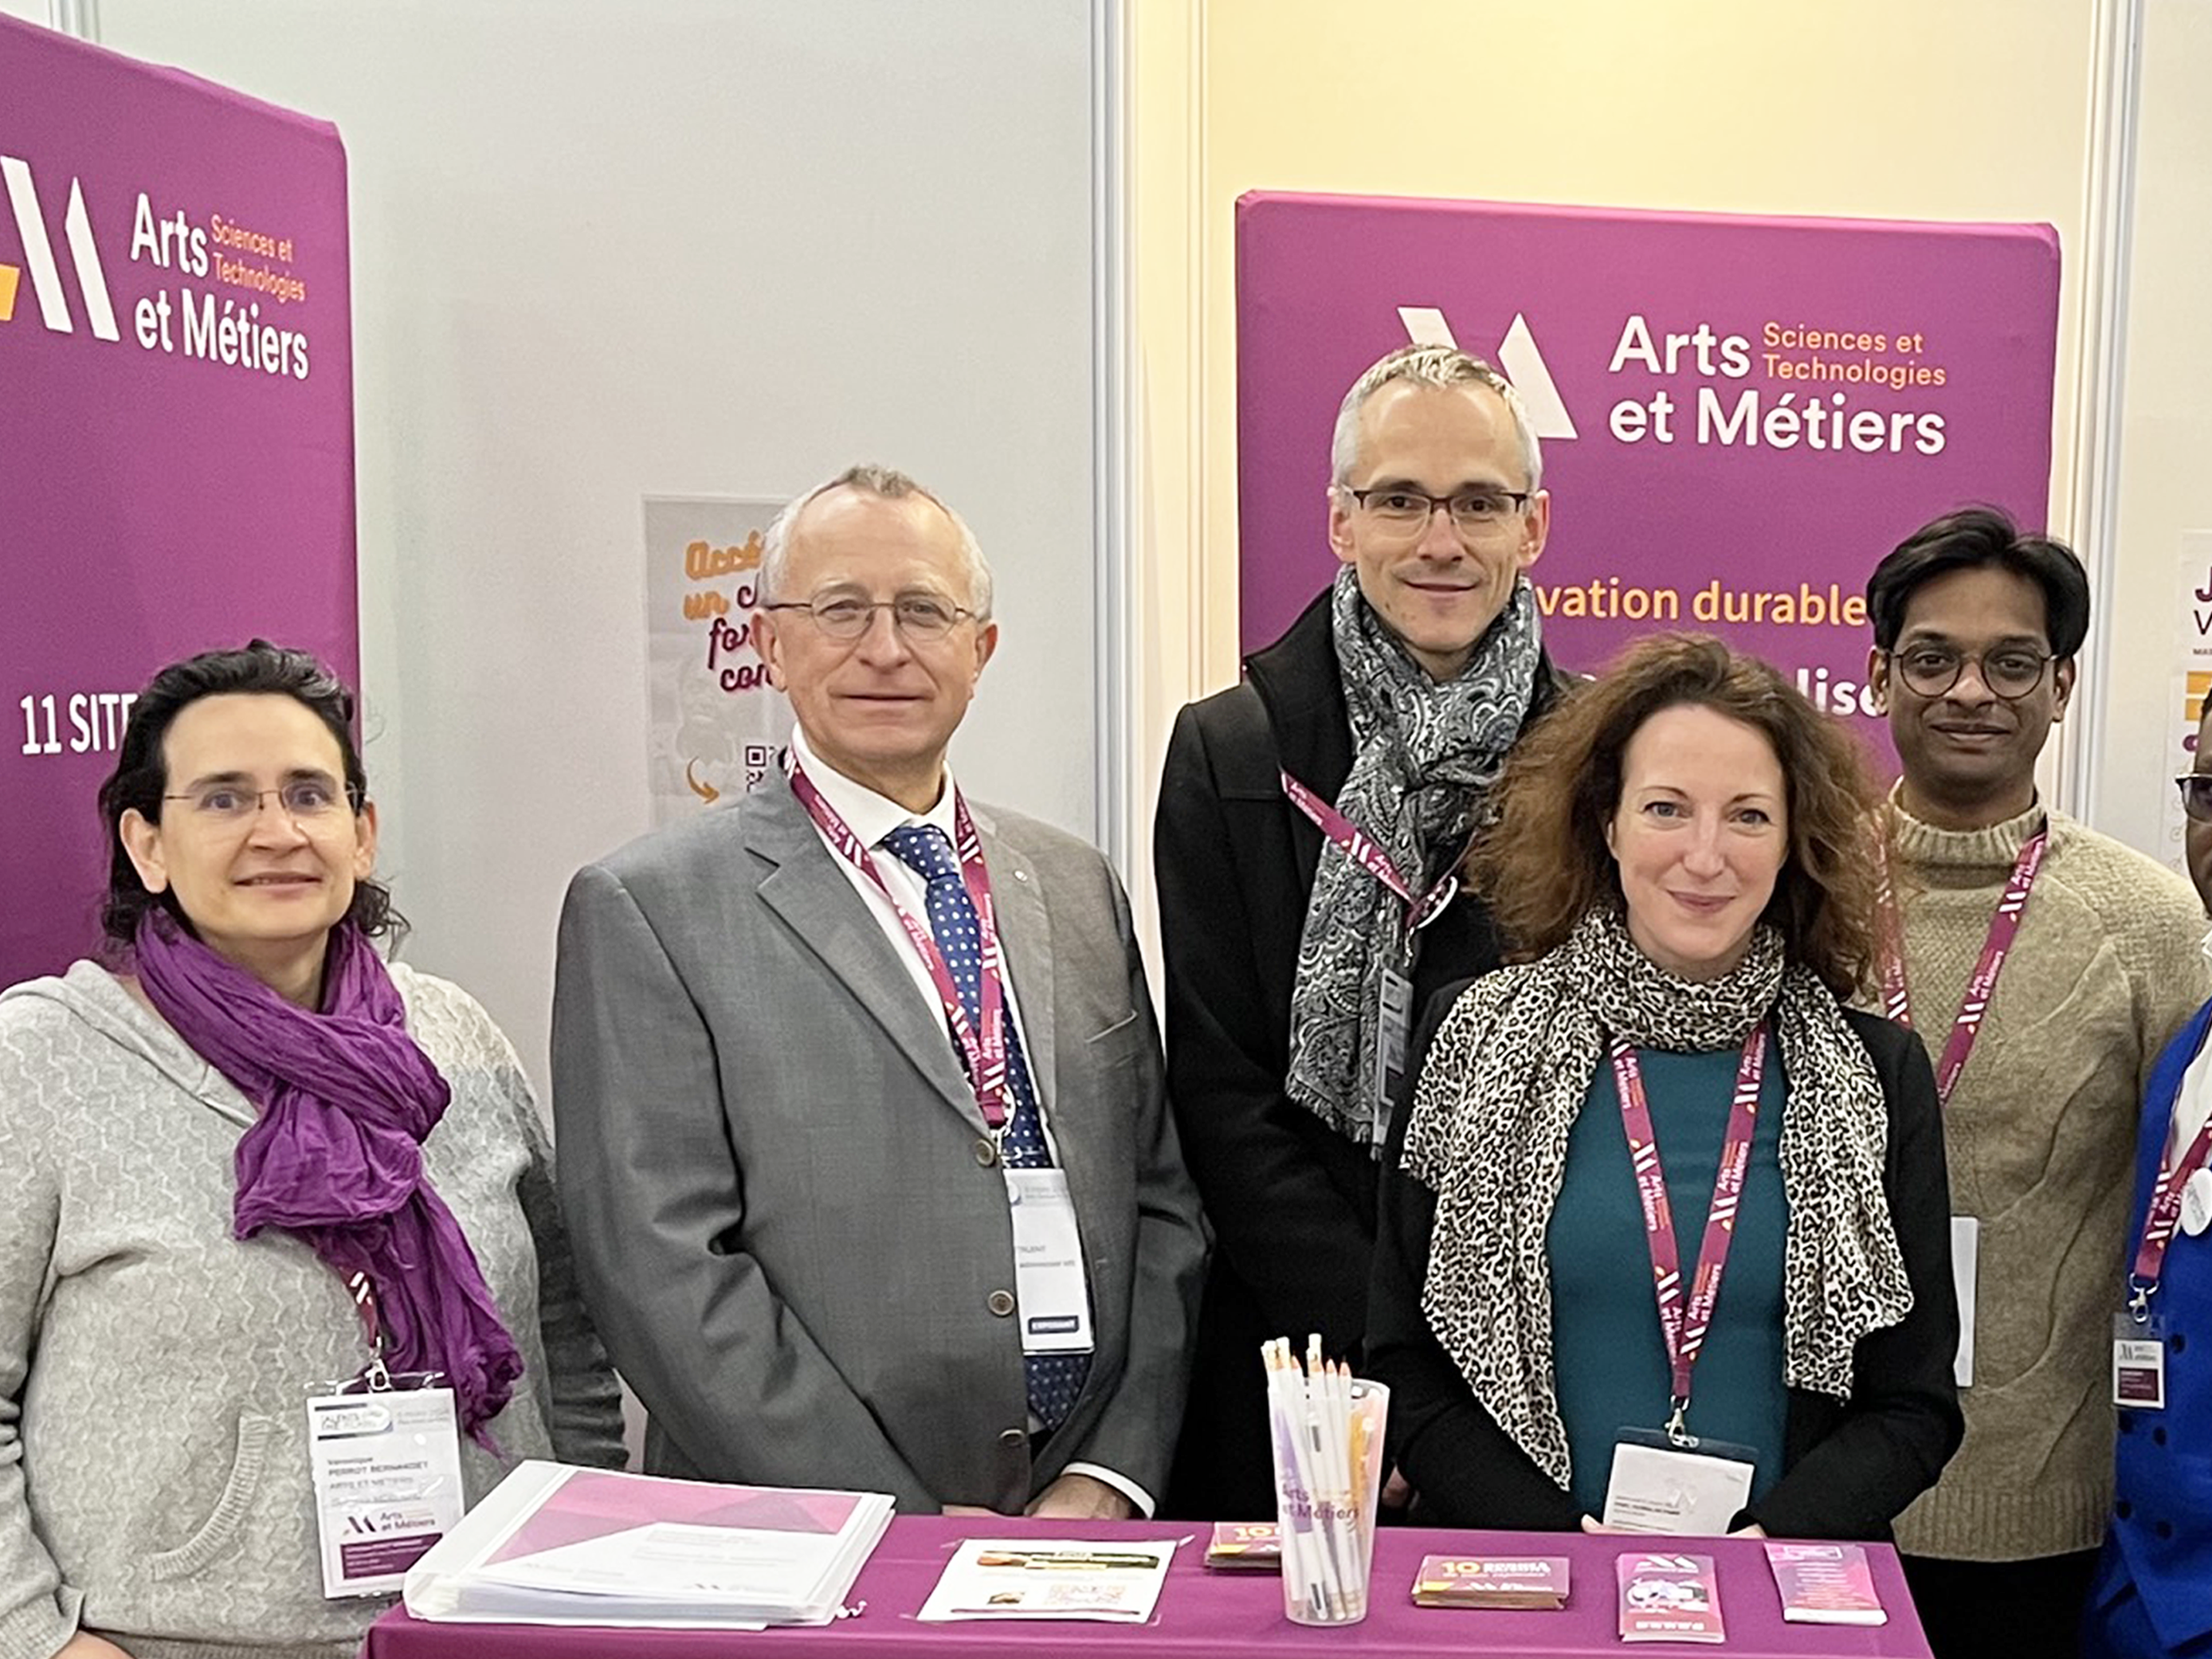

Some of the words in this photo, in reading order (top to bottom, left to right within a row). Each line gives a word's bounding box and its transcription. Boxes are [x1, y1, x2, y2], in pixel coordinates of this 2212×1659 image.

[131, 193, 209, 277] Arts
[211, 214, 276, 256] Sciences
[279, 239, 292, 261] et
[213, 253, 306, 302] Technologies
[135, 290, 173, 352] et
[182, 288, 308, 379] Métiers
[1609, 316, 1751, 377] Arts
[1763, 323, 1886, 352] Sciences
[1896, 332, 1924, 354] et
[1763, 355, 1947, 390] Technologies
[1609, 390, 1674, 443] et
[1697, 388, 1947, 455] Métiers
[1692, 580, 1866, 626] durable
[21, 695, 61, 754] 11
[1233, 1527, 1273, 1538] 10
[1441, 1561, 1481, 1574] 10
